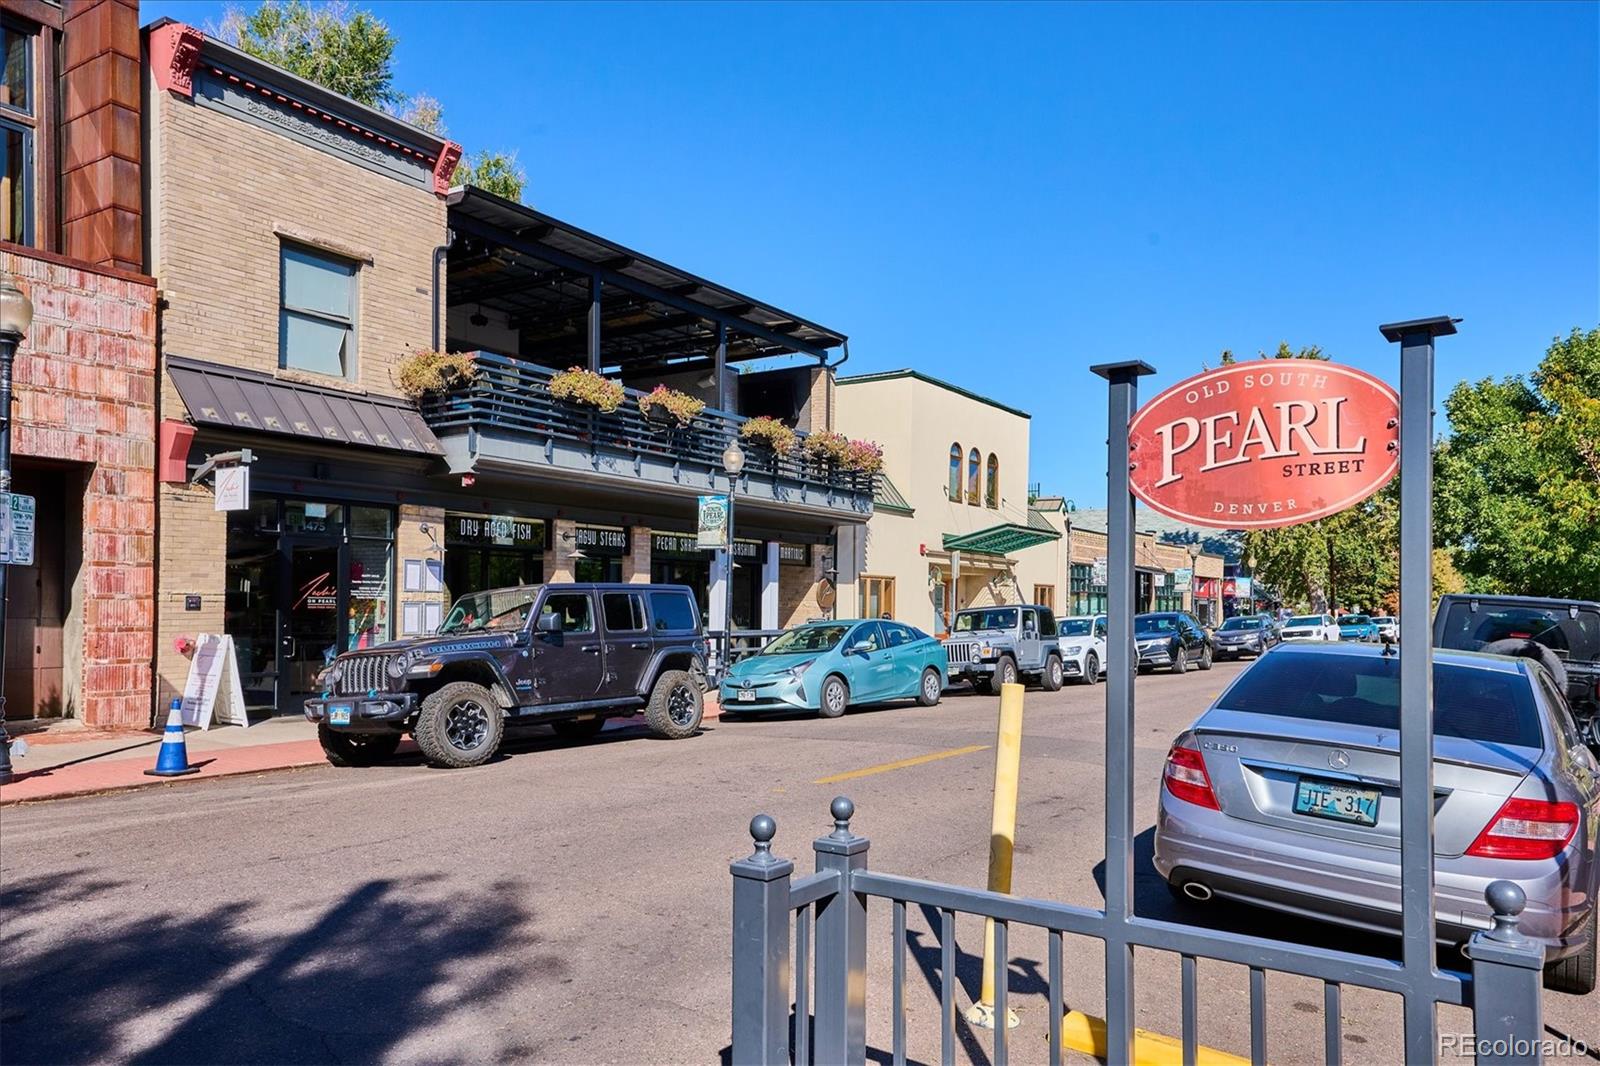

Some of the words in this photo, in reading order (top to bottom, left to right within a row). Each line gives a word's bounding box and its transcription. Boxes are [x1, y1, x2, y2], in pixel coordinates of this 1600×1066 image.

[1185, 380, 1231, 404] OLD
[1244, 372, 1329, 390] SOUTH
[1154, 396, 1367, 489] PEARL
[1282, 459, 1366, 478] STREET
[1213, 498, 1298, 516] DENVER
[460, 519, 479, 536] DRY
[484, 520, 507, 538] AGED
[511, 524, 532, 541] FISH
[600, 532, 626, 548] STEAKS
[656, 536, 677, 551] PECAN
[429, 640, 501, 654] RUBICON
